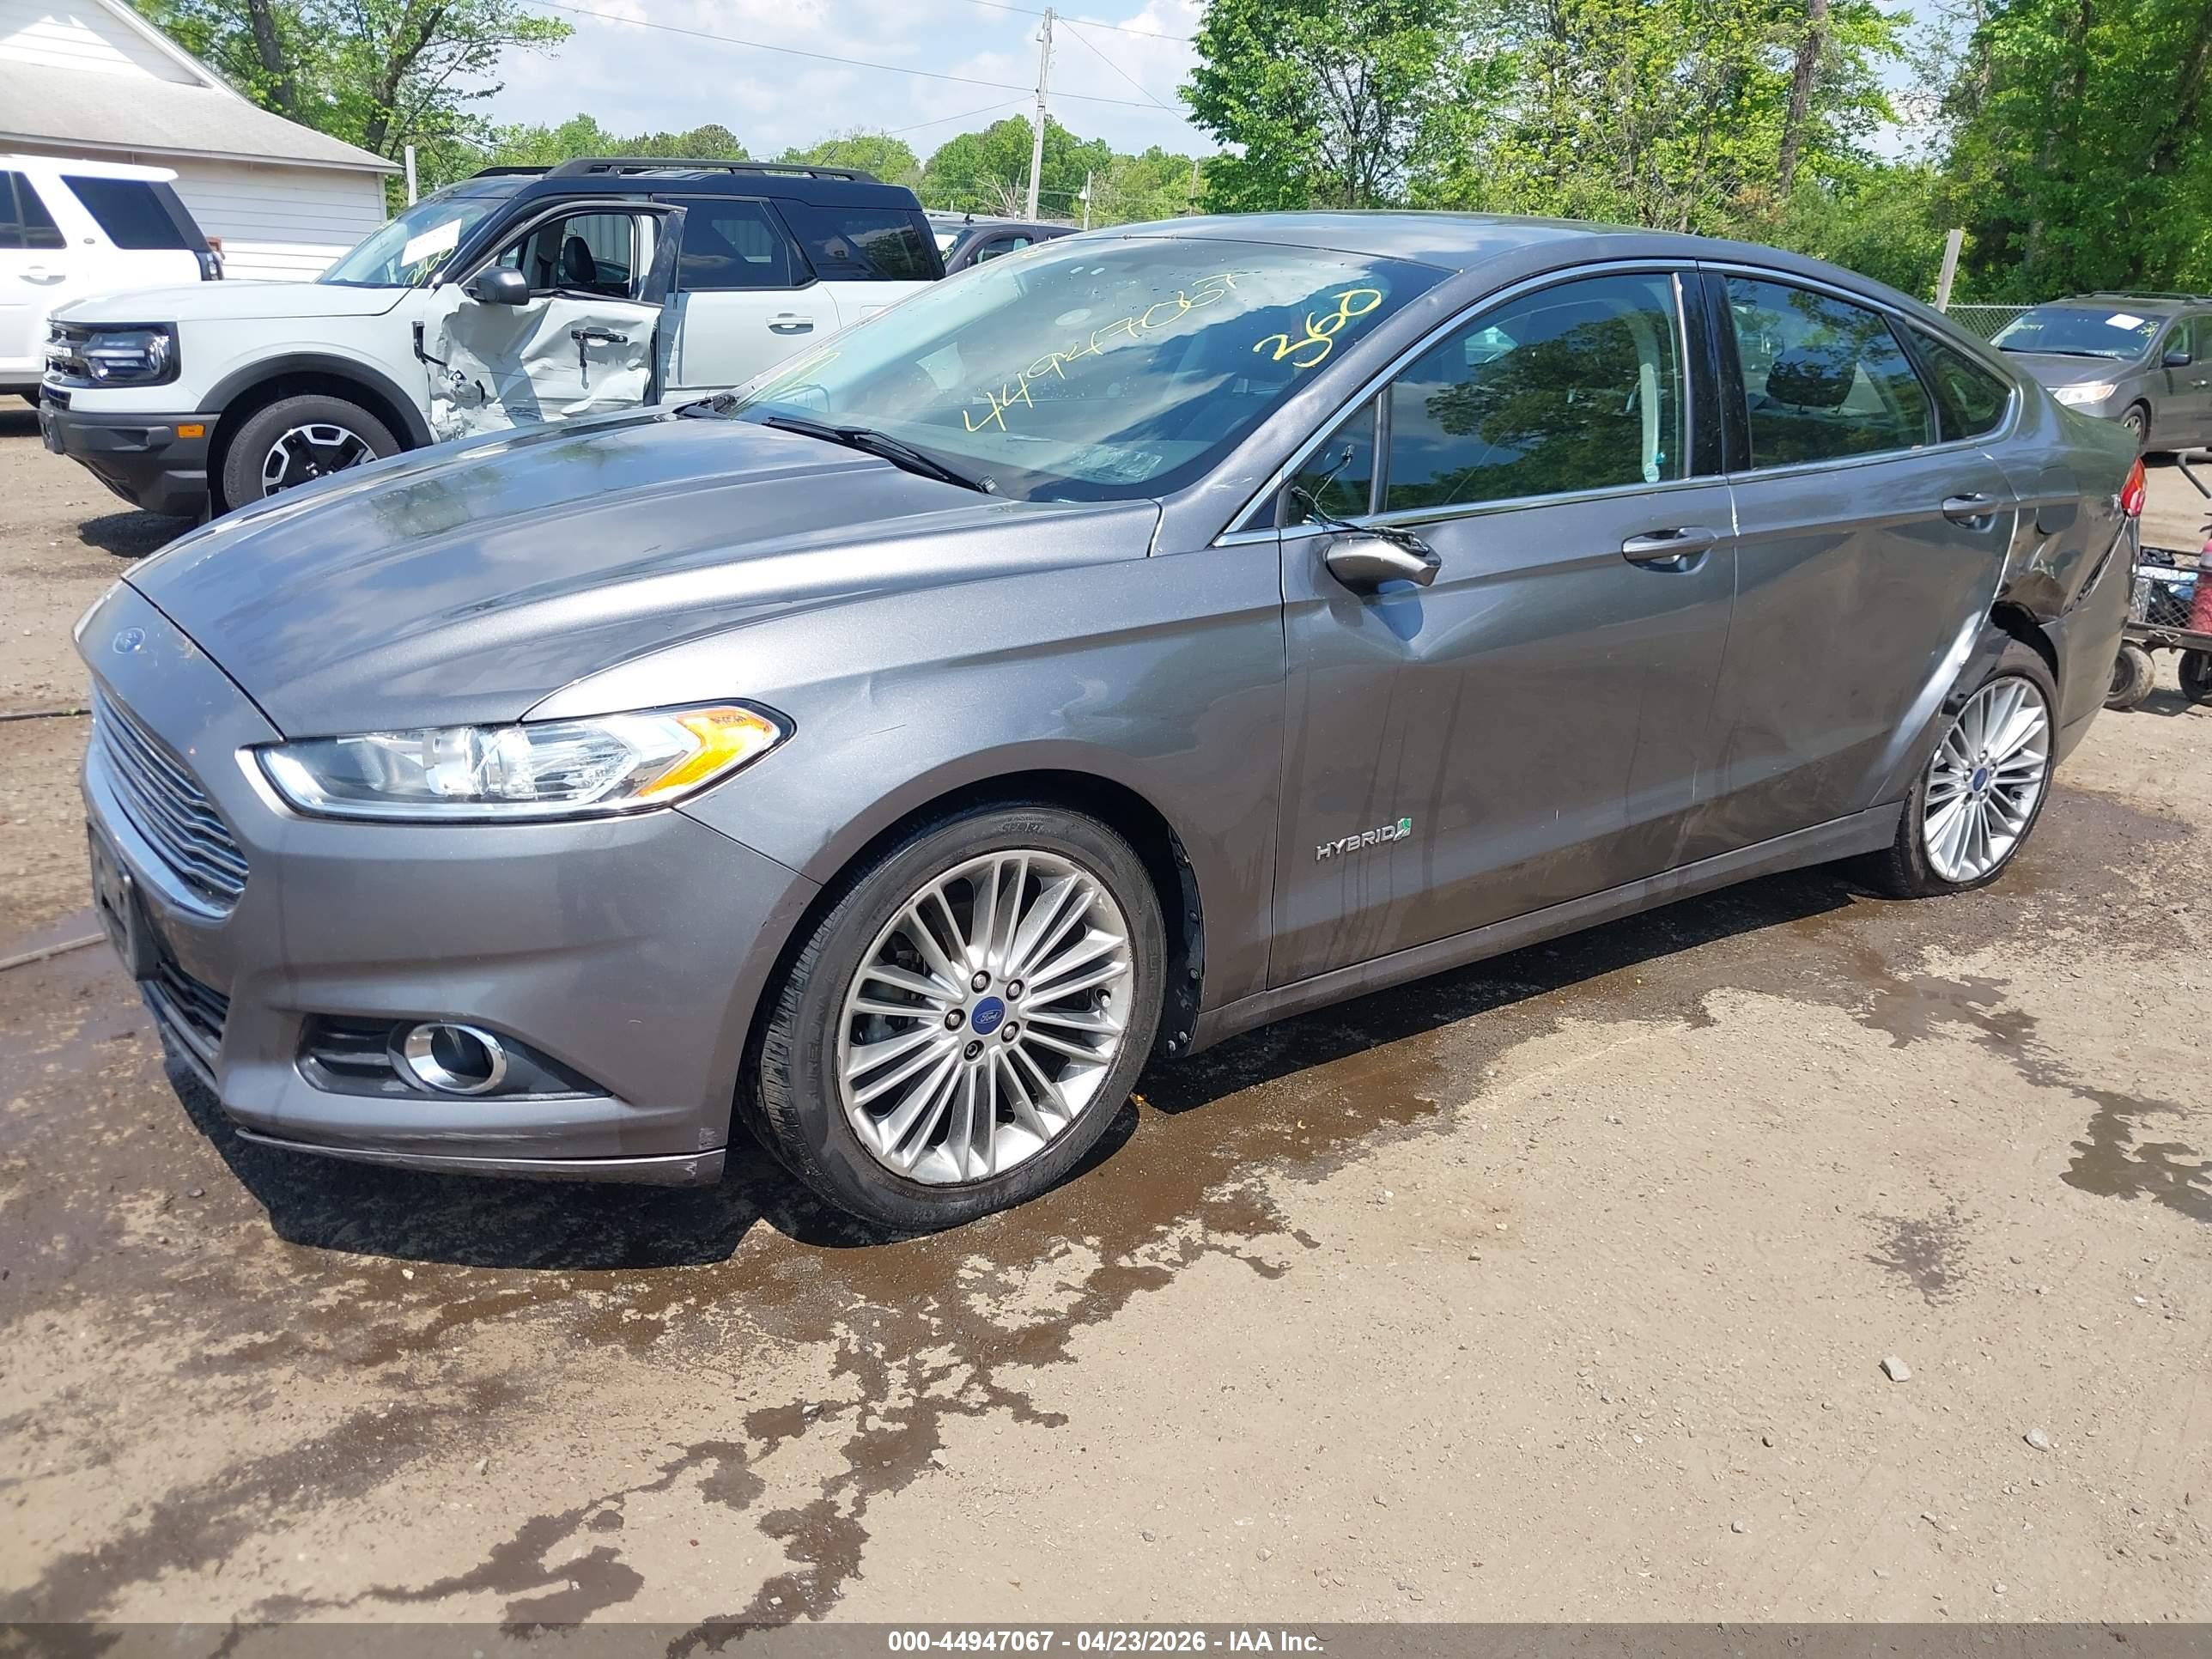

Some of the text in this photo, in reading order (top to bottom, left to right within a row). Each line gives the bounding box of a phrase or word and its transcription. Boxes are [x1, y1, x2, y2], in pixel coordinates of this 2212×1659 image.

[1252, 288, 1382, 368] 360
[1316, 825, 1395, 861] HYBRID
[980, 1011, 999, 1023] Ford
